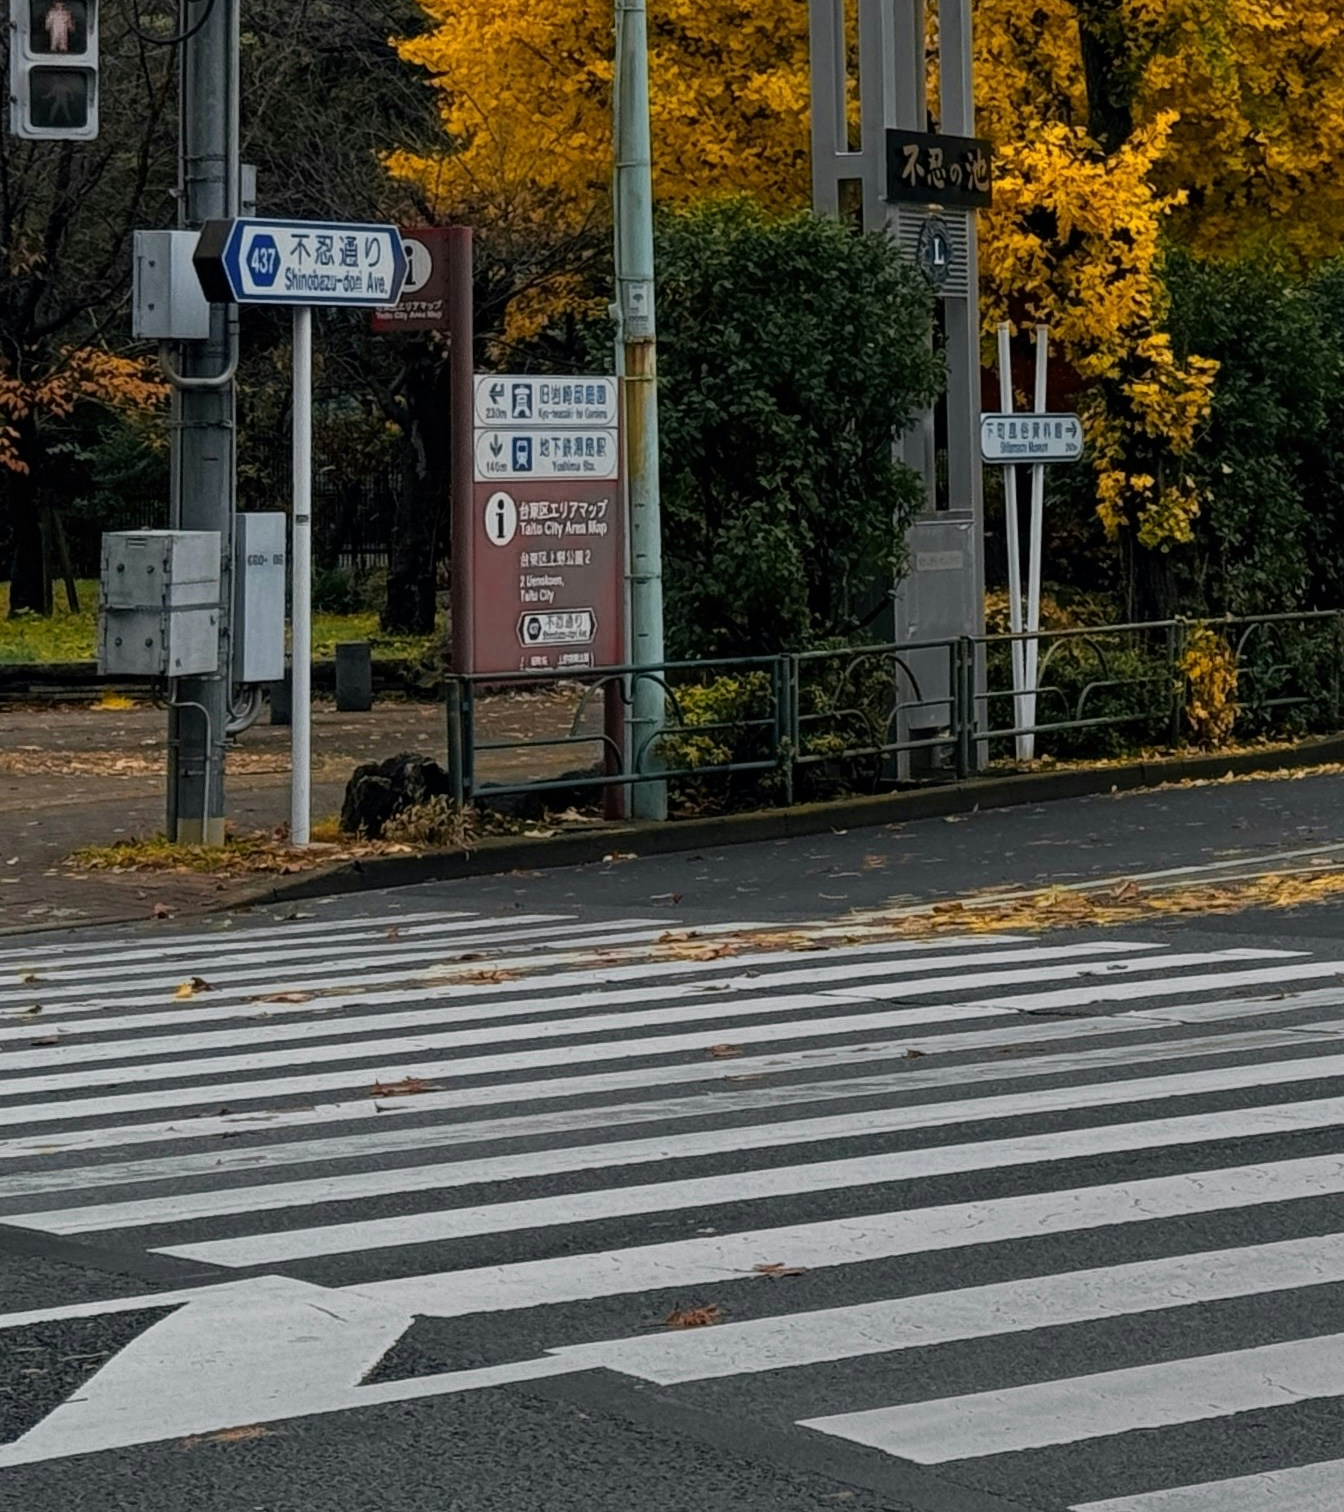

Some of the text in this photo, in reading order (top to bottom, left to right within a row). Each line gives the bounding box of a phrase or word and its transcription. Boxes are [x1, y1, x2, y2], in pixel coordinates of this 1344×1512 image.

[902, 143, 989, 192] 不忍の池
[251, 248, 275, 274] 437
[290, 234, 381, 267] 不忍通り
[367, 271, 389, 294] Ave.
